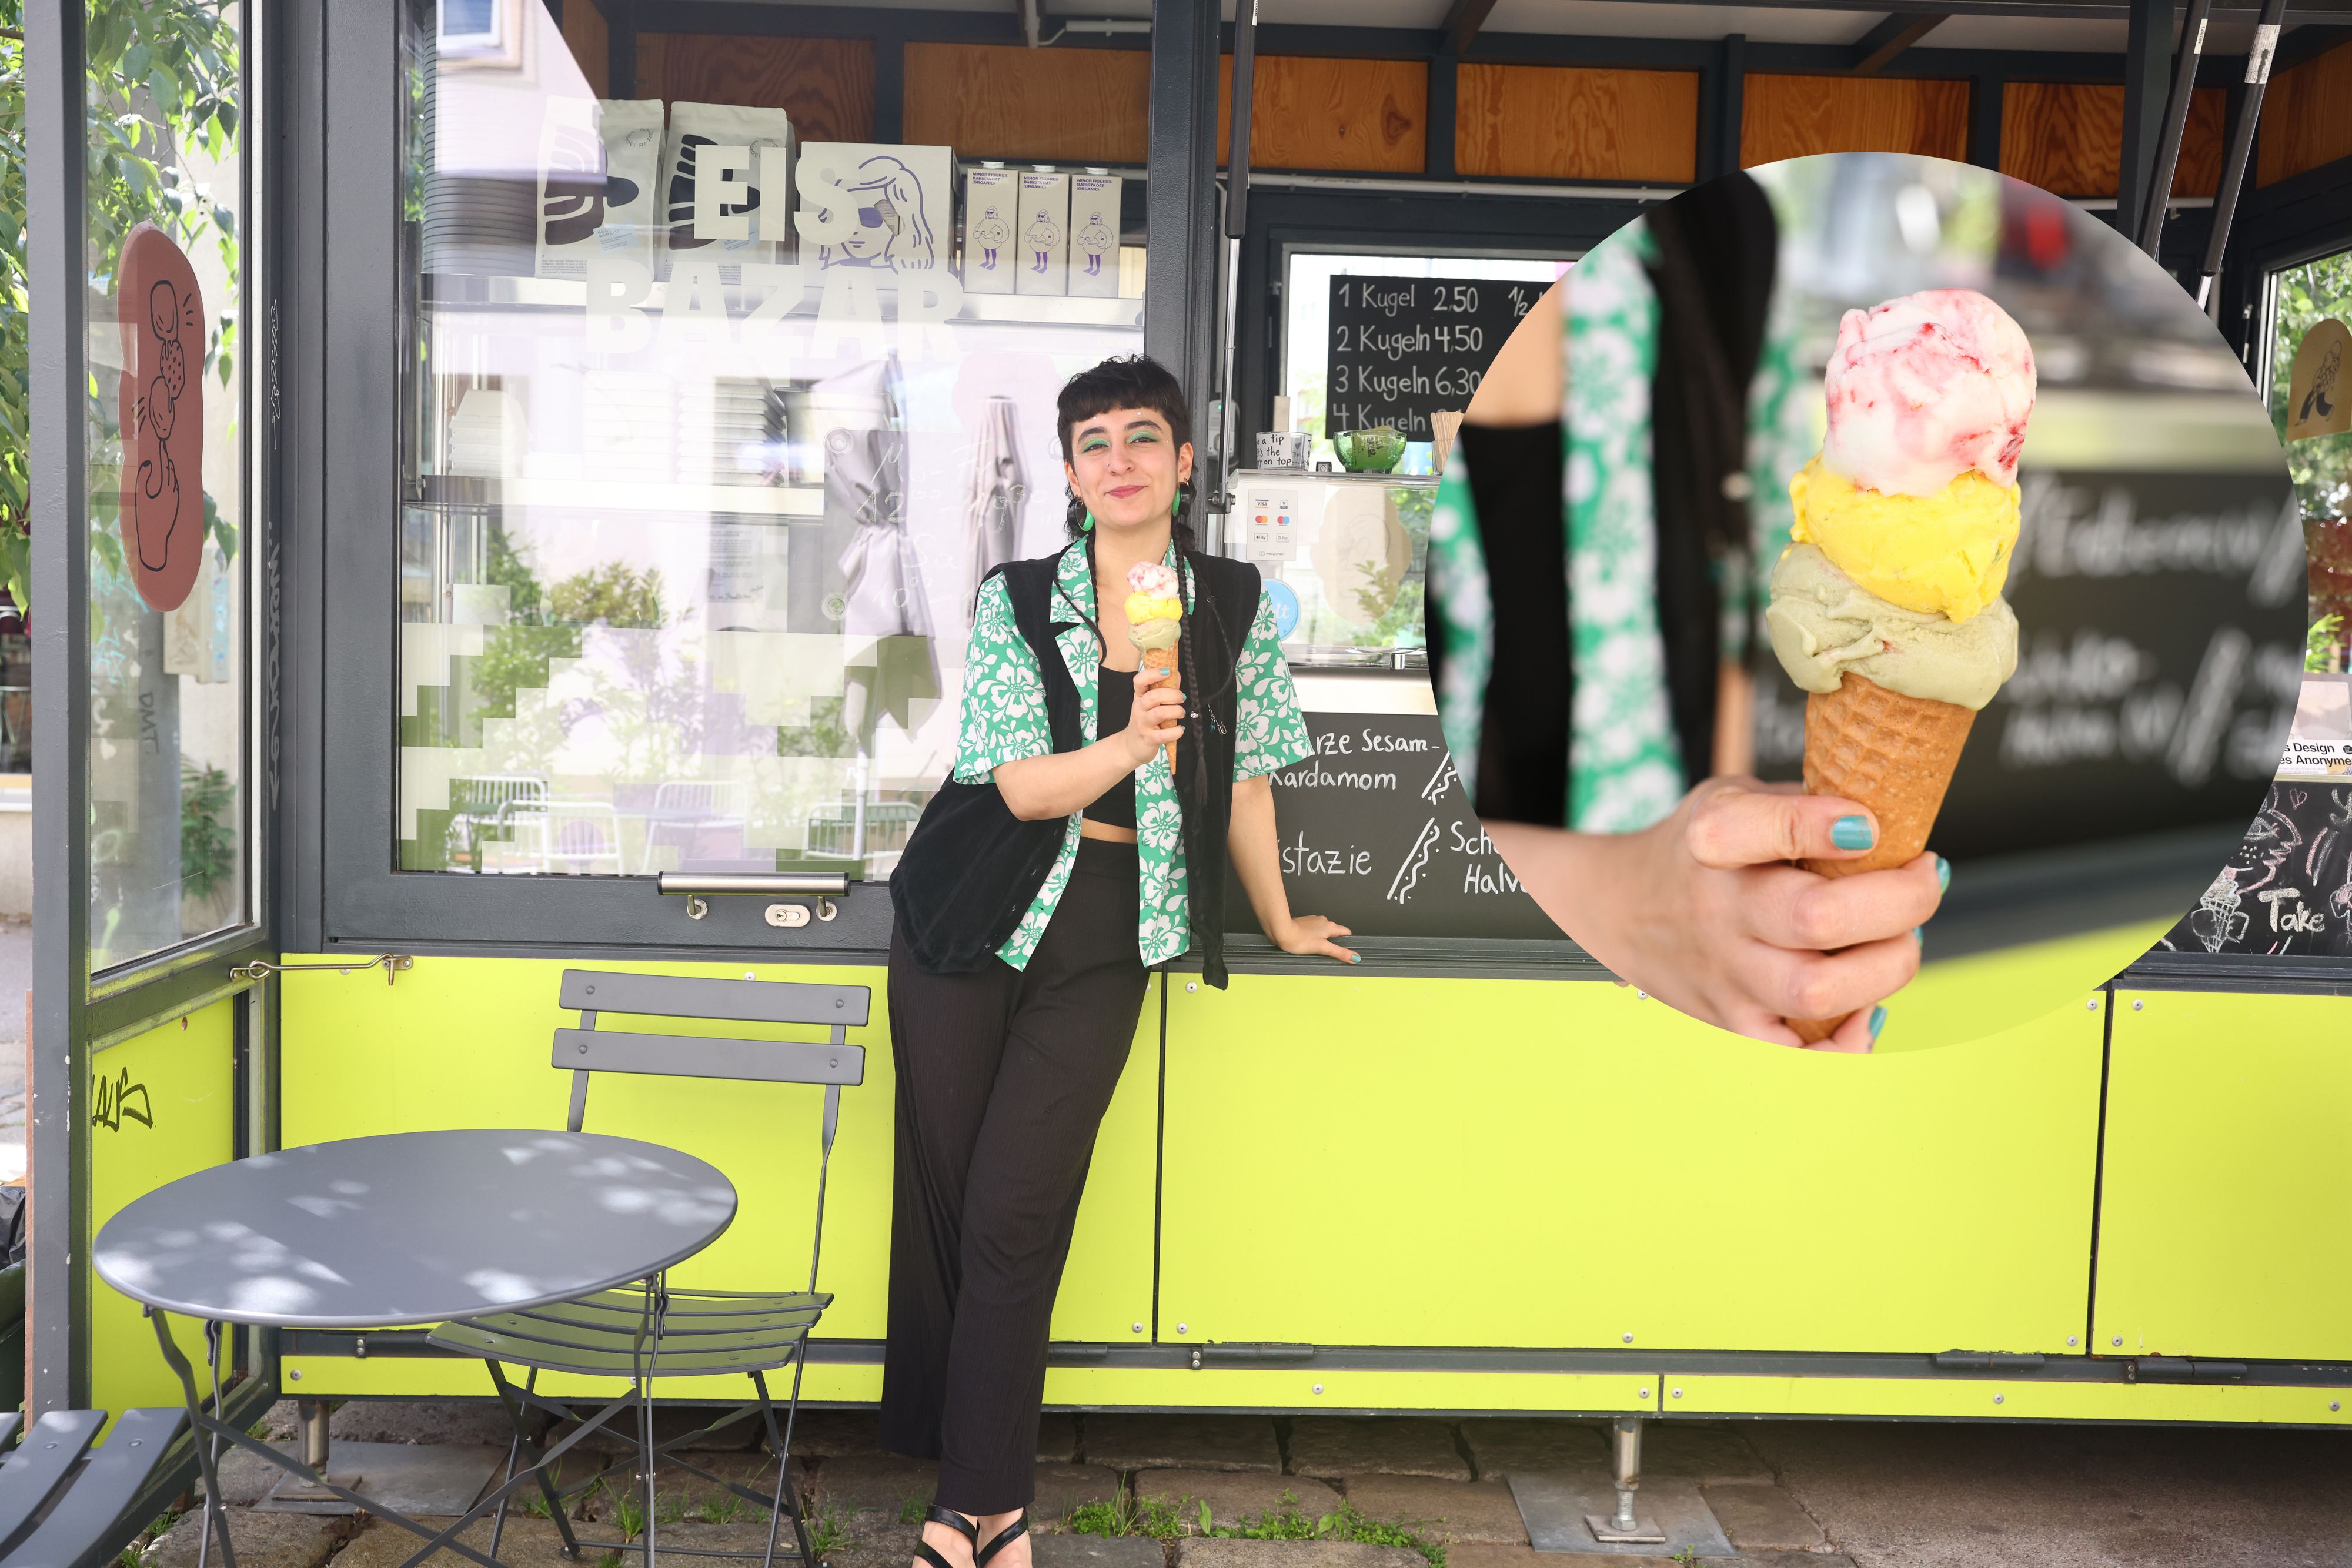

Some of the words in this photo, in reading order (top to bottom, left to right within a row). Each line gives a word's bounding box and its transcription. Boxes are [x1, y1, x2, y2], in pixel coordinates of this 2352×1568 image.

[694, 145, 860, 245] EIS
[587, 259, 964, 362] BAZAR
[1339, 283, 1350, 307] 1
[1362, 283, 1415, 317] Kugel
[1432, 286, 1478, 313] 2,50
[1337, 325, 1352, 352] 2
[1359, 324, 1430, 361] Kugeln
[1435, 325, 1483, 353] 4,50
[1335, 365, 1349, 393] 3
[1358, 365, 1429, 402] Kugeln
[1333, 403, 1350, 430] 4
[1266, 446, 1280, 456] the
[1271, 434, 1284, 445] tip
[1277, 457, 1292, 467] top
[2293, 743, 2335, 754] Design
[1450, 821, 1500, 855] Sch
[2257, 887, 2325, 933] Take
